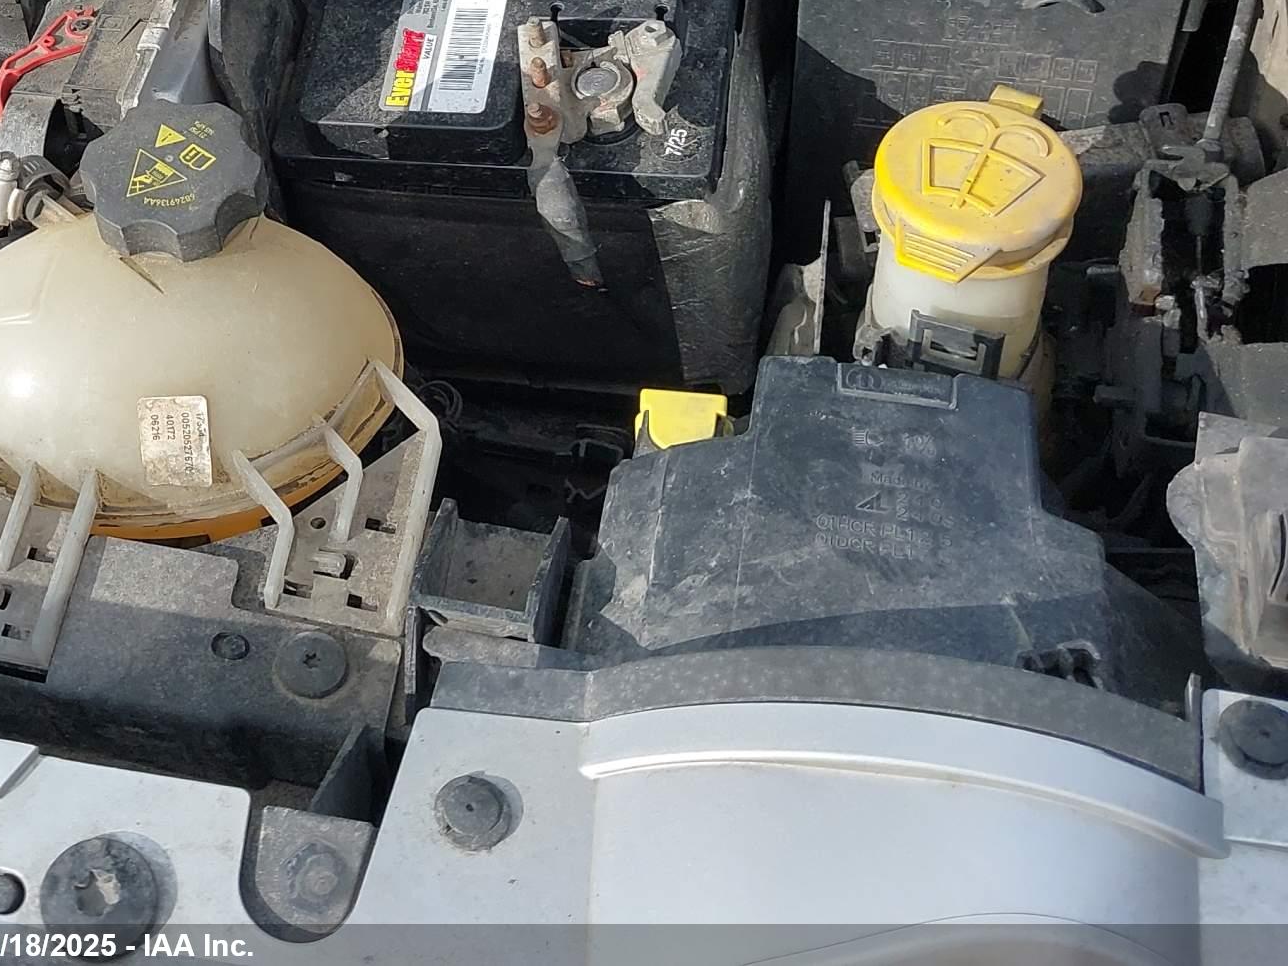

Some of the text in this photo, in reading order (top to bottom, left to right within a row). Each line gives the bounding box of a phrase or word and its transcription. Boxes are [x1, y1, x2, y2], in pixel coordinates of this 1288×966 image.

[422, 36, 435, 60] VALUE
[385, 28, 425, 107] EverStart
[663, 128, 688, 156] 7/25
[150, 414, 160, 441] 06216
[166, 414, 176, 440] 40172
